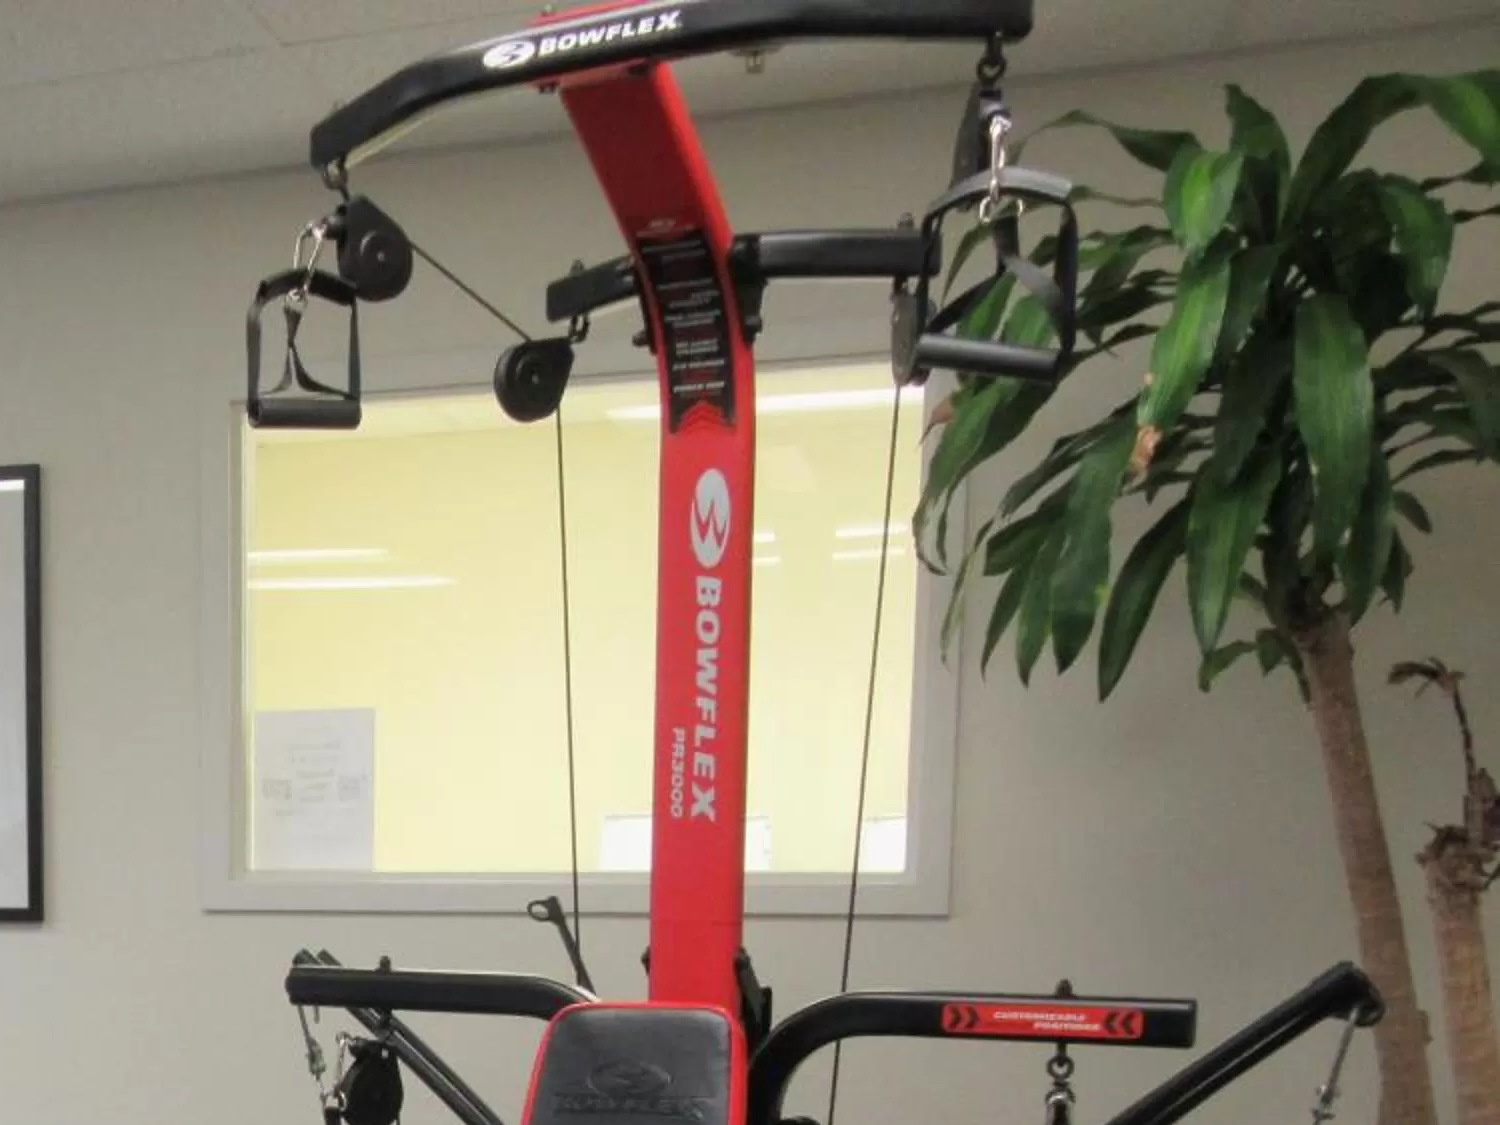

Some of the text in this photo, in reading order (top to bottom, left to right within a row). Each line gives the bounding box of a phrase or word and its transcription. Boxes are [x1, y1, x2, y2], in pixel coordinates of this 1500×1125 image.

[538, 10, 681, 57] BOWFLEX
[691, 575, 722, 822] BOWFLEX
[670, 727, 686, 818] PR3000
